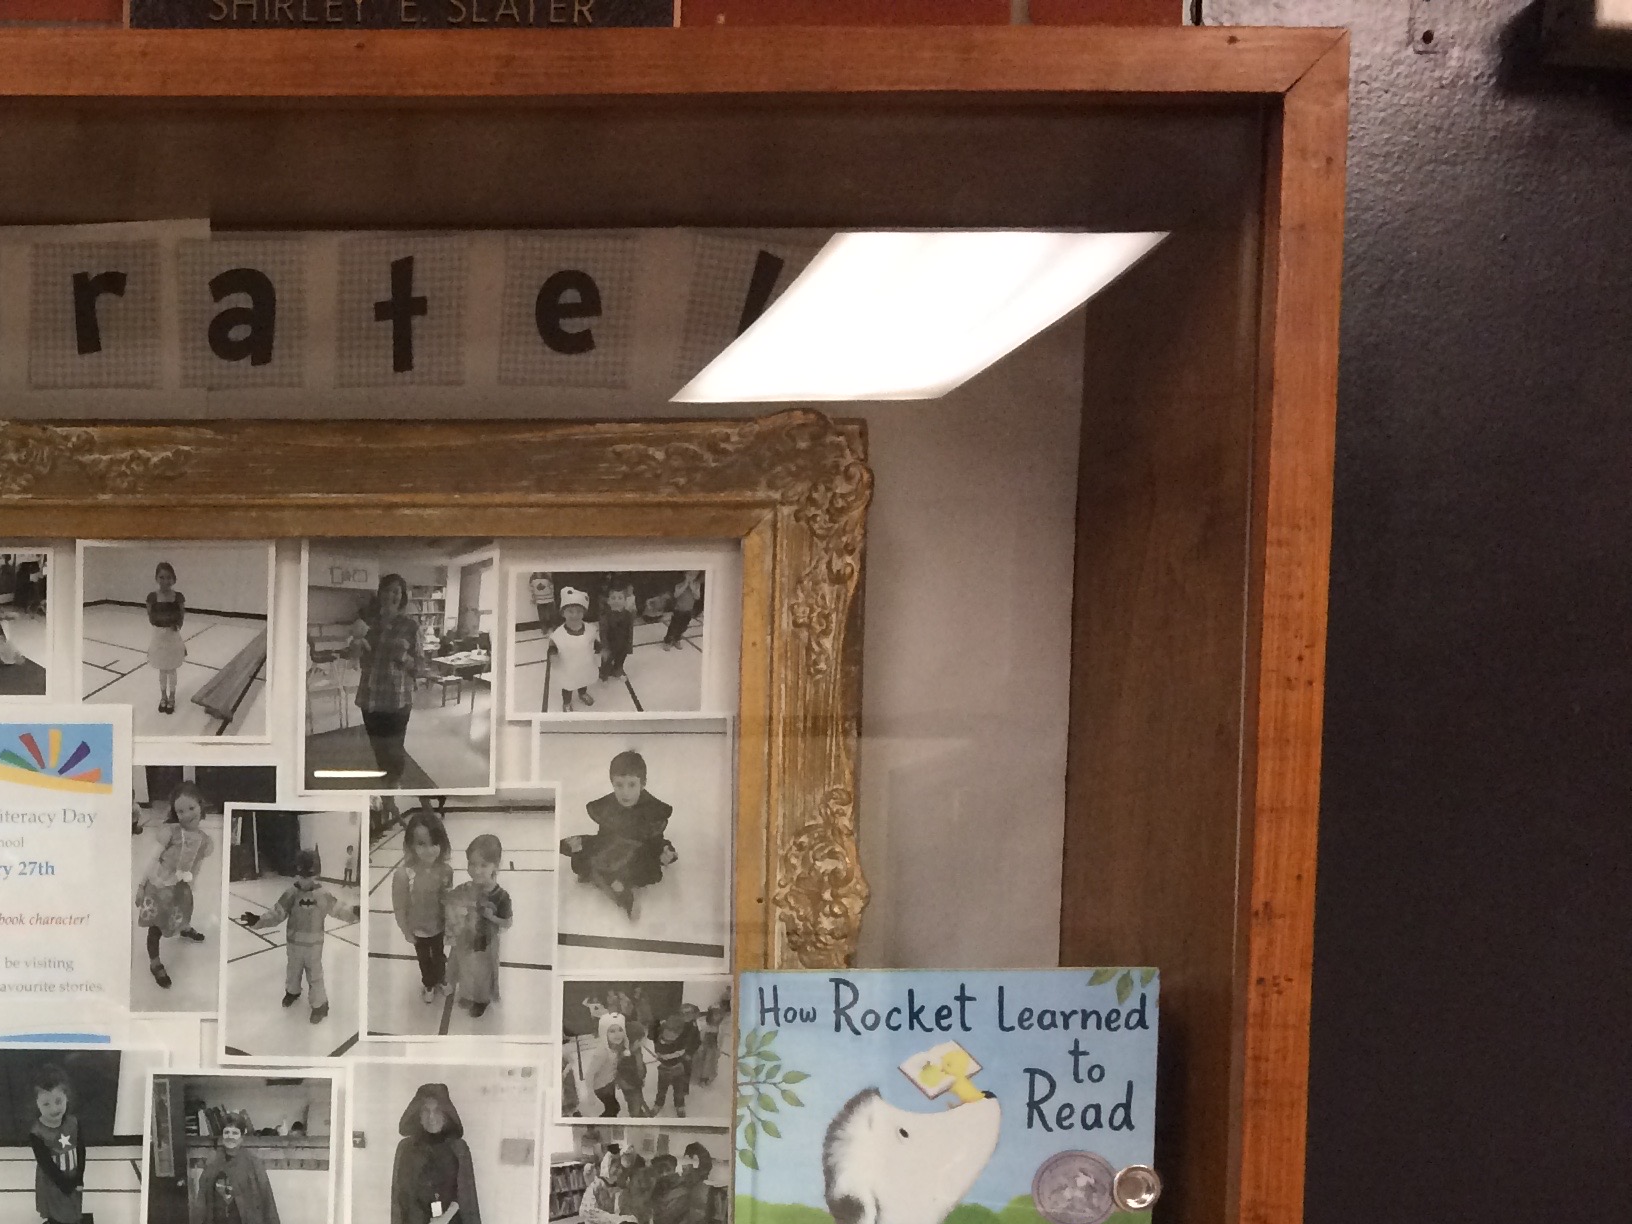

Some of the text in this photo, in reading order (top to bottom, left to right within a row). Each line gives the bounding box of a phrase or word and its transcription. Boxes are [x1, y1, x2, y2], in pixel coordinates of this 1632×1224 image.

[62, 808, 98, 828] Day
[18, 861, 56, 877] 27th
[4, 956, 20, 969] be
[24, 956, 75, 973] visiting
[758, 977, 1150, 1036] How Rocket Learned
[1068, 1038, 1106, 1085] to
[1023, 1067, 1136, 1132] Read
